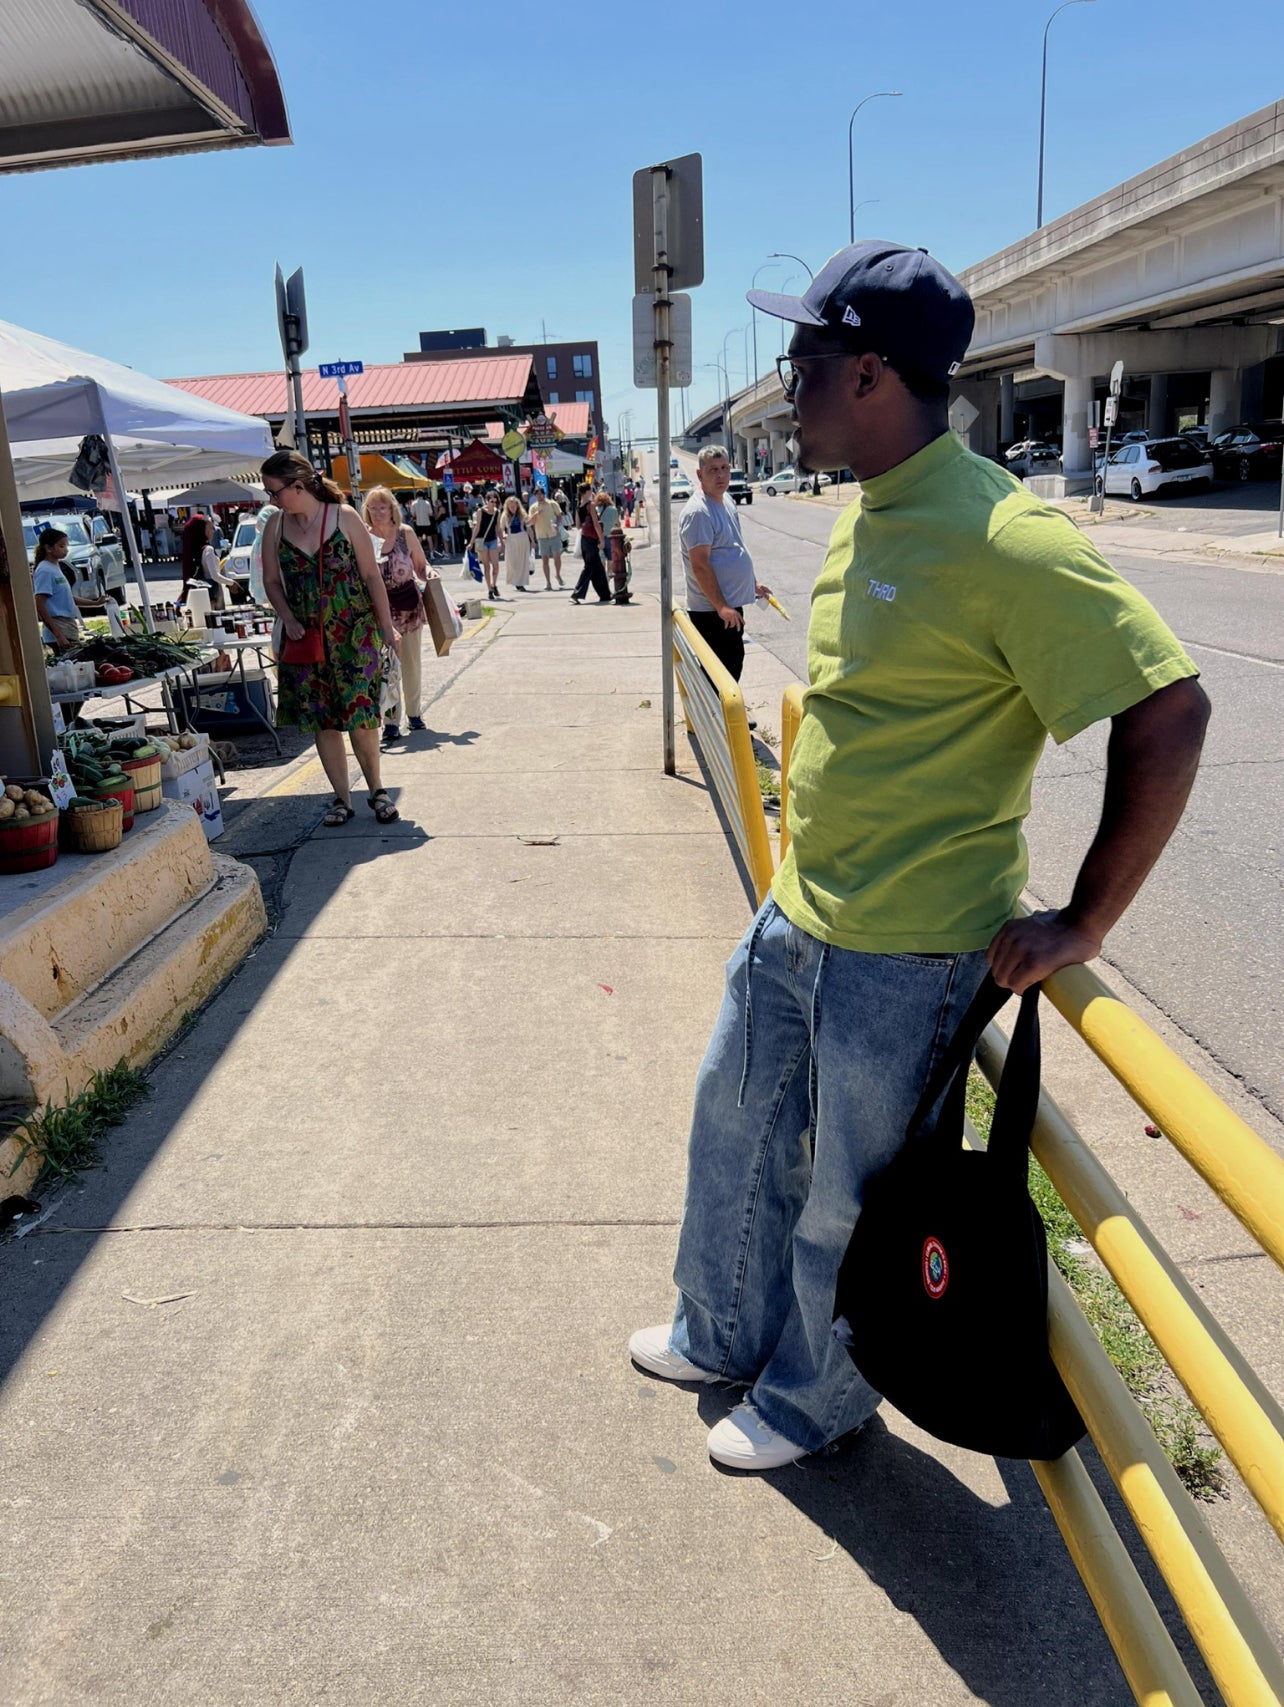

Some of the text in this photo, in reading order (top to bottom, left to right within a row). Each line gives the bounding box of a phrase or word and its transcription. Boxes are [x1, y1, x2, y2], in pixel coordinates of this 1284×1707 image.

[322, 363, 360, 375] N 3rd Av
